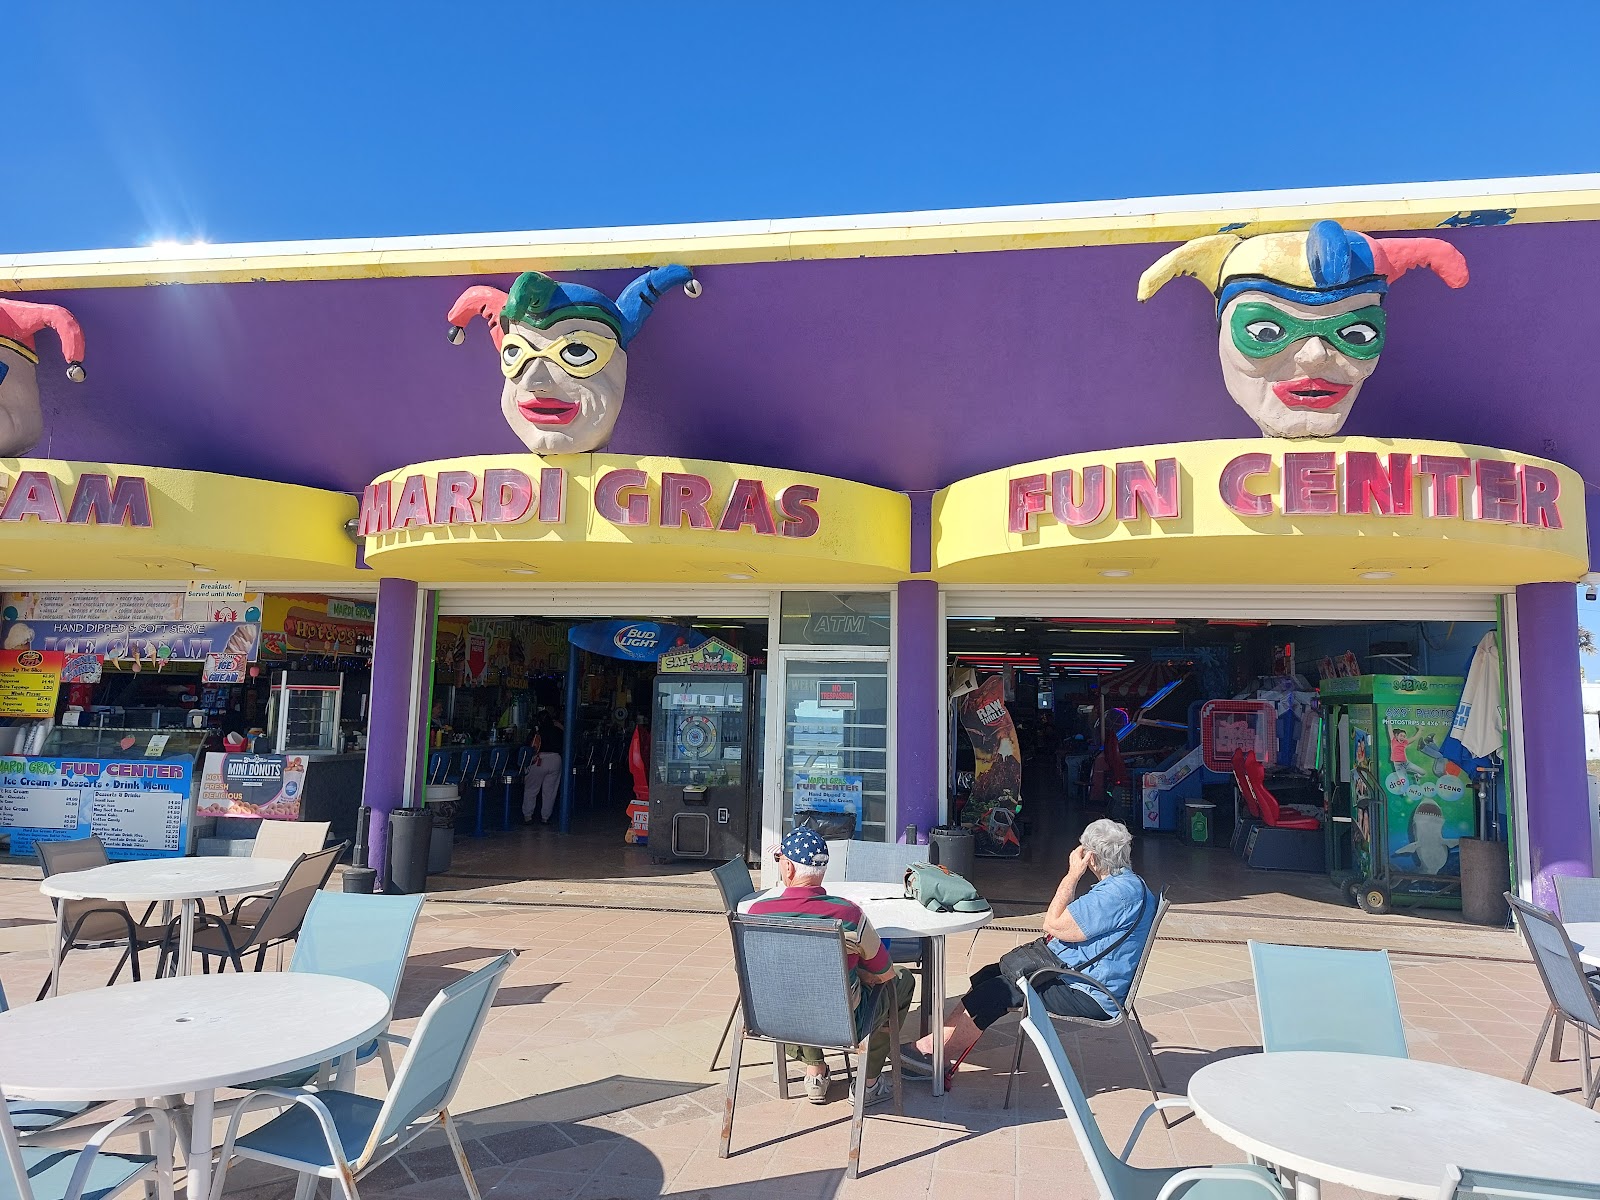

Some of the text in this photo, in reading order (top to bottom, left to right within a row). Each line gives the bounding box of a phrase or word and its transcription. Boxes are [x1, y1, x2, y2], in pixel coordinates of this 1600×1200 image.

[0, 471, 154, 528] AM
[1009, 451, 1566, 534] FUN CENTER
[358, 467, 821, 539] MARDI GRAS
[333, 603, 354, 618] MARDI
[54, 623, 84, 633] HAND
[86, 624, 126, 633] DIPPED
[138, 624, 169, 634] SOFT
[169, 624, 205, 634] SERVE
[814, 616, 865, 632] ATM
[262, 633, 287, 642] PIZZA
[627, 629, 656, 638] BUD
[45, 637, 97, 656] ICE
[621, 637, 658, 647] LIGHT
[665, 654, 694, 668] SAFE
[690, 662, 739, 671] CRACKER
[208, 672, 239, 682] CREAM
[832, 684, 841, 692] NO
[1393, 679, 1428, 691] scene
[976, 699, 1002, 720] RAW
[981, 709, 1006, 726] THRILLS
[29, 761, 56, 774] GRAS
[61, 762, 99, 776] FUN
[106, 763, 183, 778] CENTER
[228, 762, 281, 776] MINI DONUTS
[4, 777, 170, 791] Ice Cream Desserts Drink Menu
[204, 783, 229, 791] FRESH
[808, 777, 828, 785] MARDI
[1389, 778, 1406, 789] drop
[1408, 788, 1422, 797] into
[1439, 783, 1462, 793] scene
[203, 792, 243, 800] DELICIOUS
